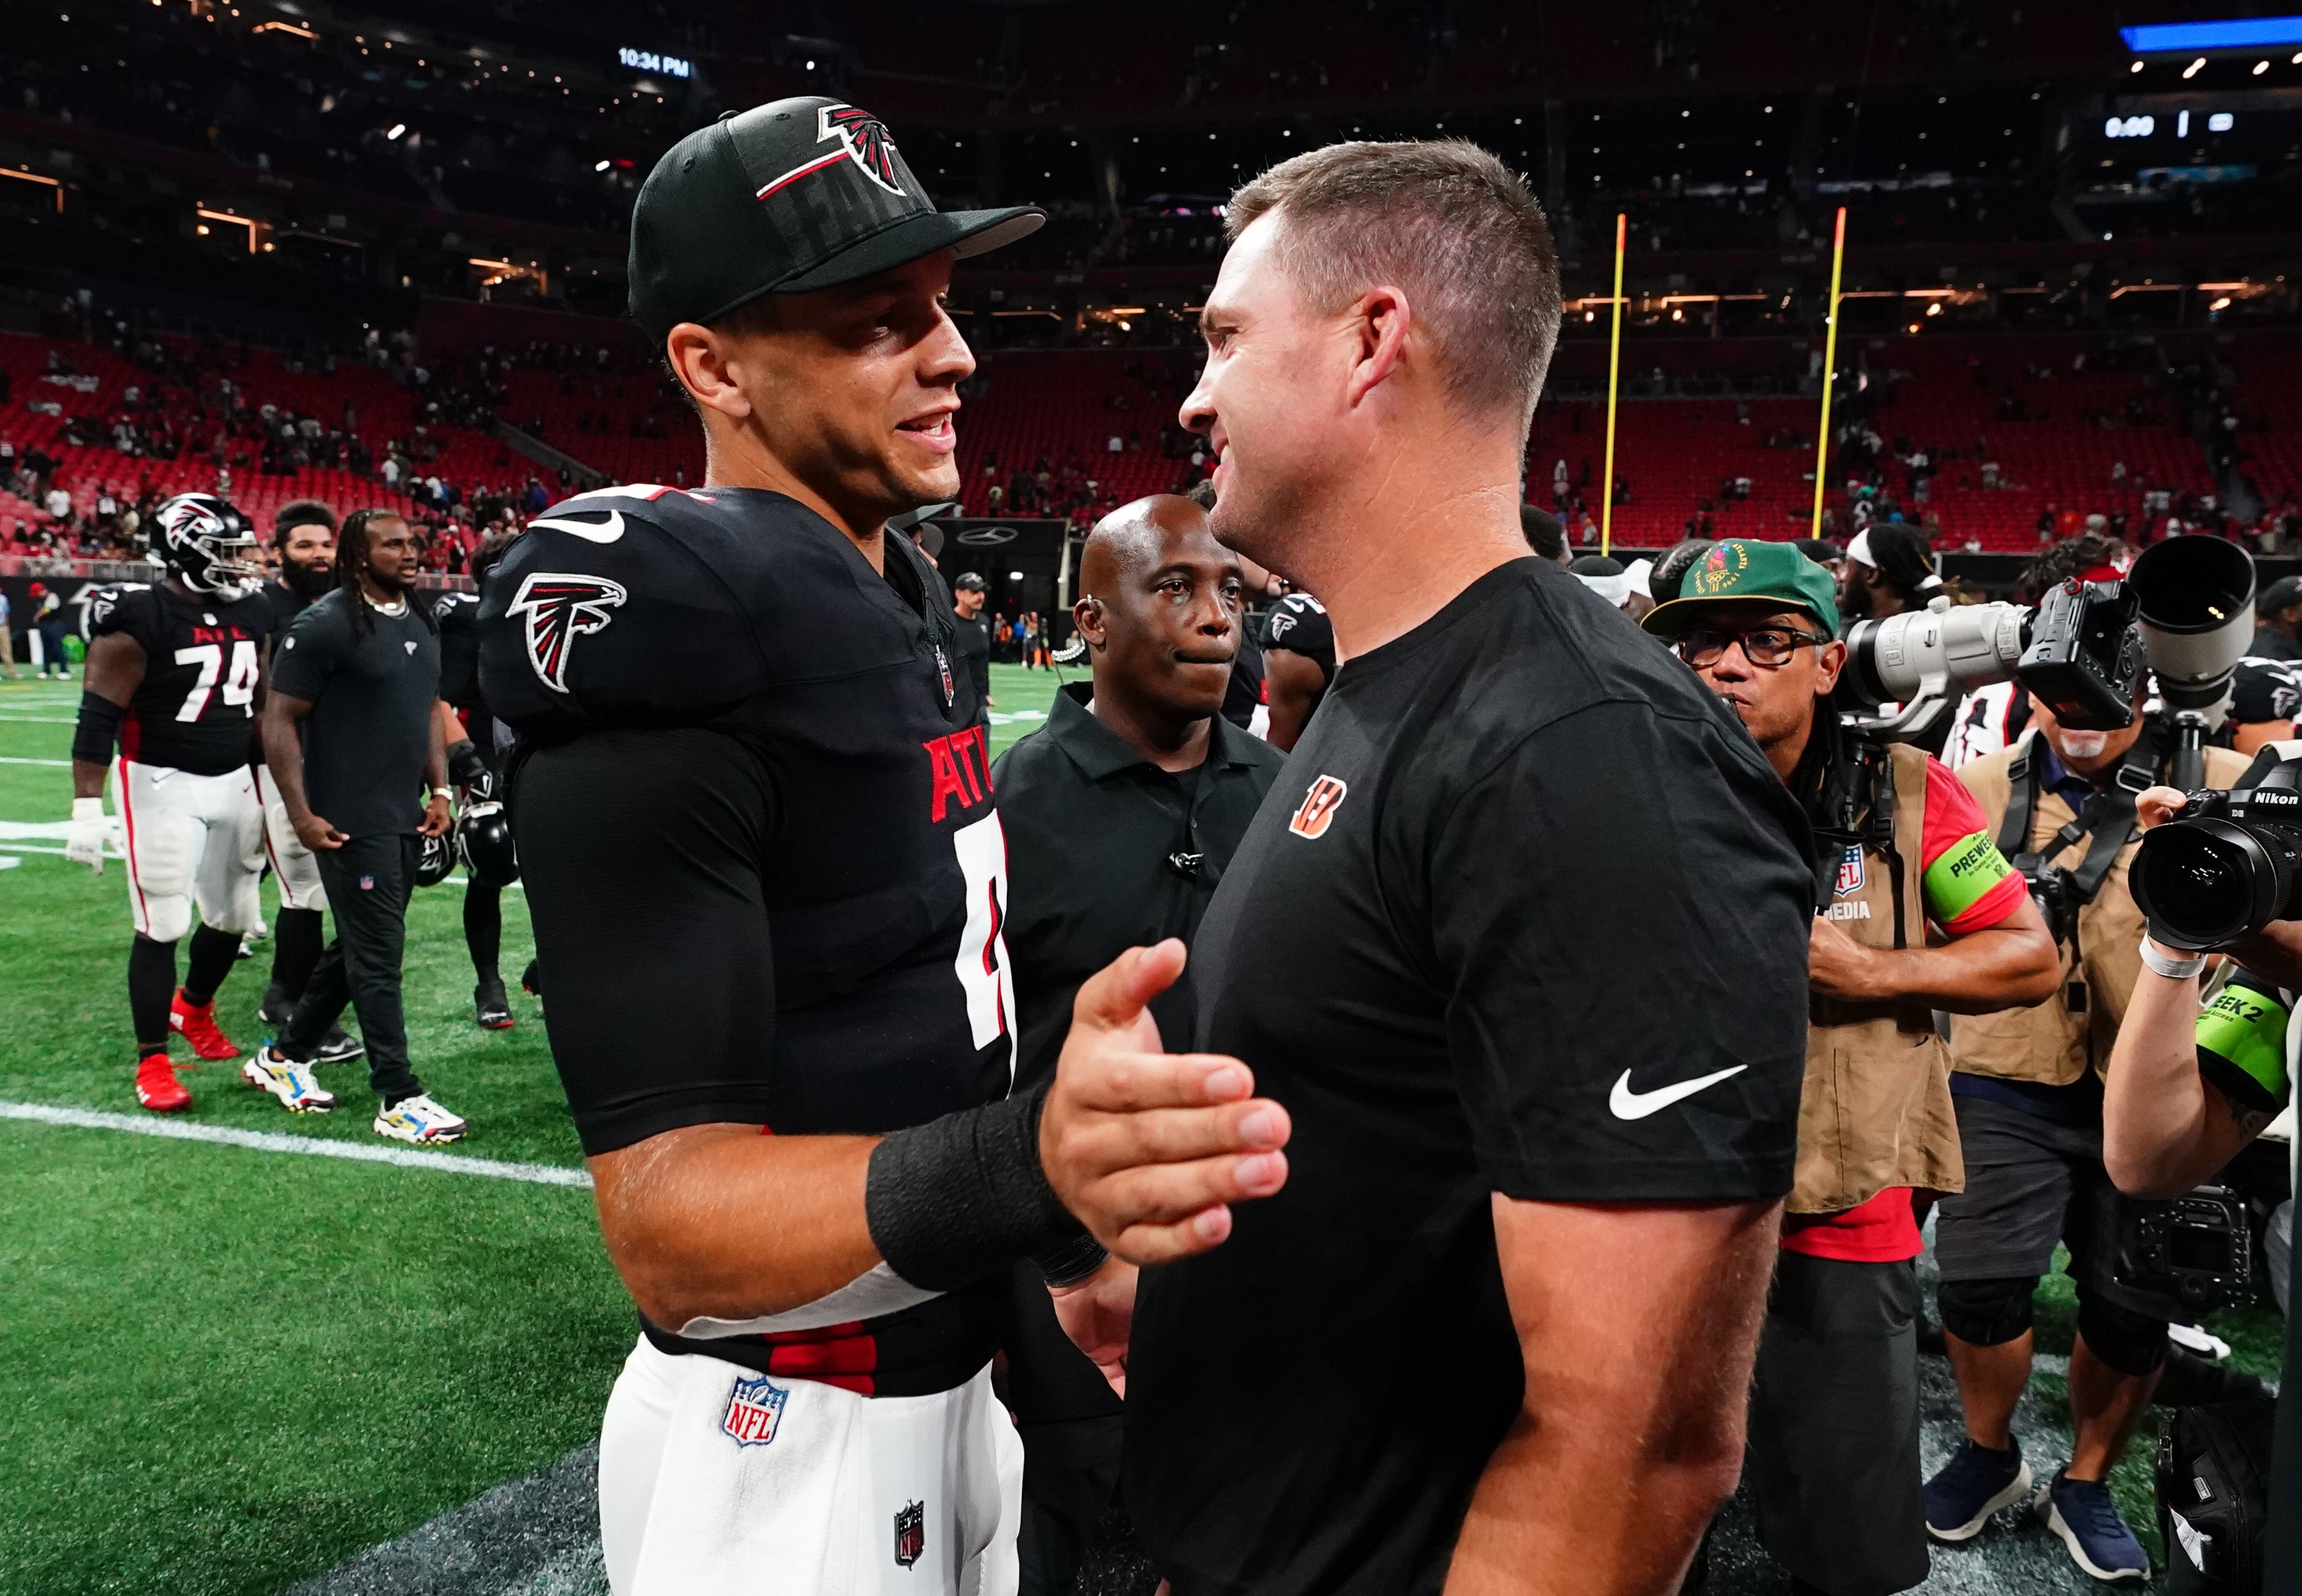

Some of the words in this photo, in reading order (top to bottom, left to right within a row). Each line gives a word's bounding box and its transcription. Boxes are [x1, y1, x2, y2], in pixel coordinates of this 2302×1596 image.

[618, 47, 660, 71] 10:34
[663, 56, 689, 78] PM
[174, 640, 261, 722] 74
[1289, 774, 1347, 840] B
[2255, 792, 2299, 805] Nikon
[1837, 865, 1859, 889] FL
[2243, 1006, 2264, 1024] 2
[726, 1403, 771, 1440] NFL
